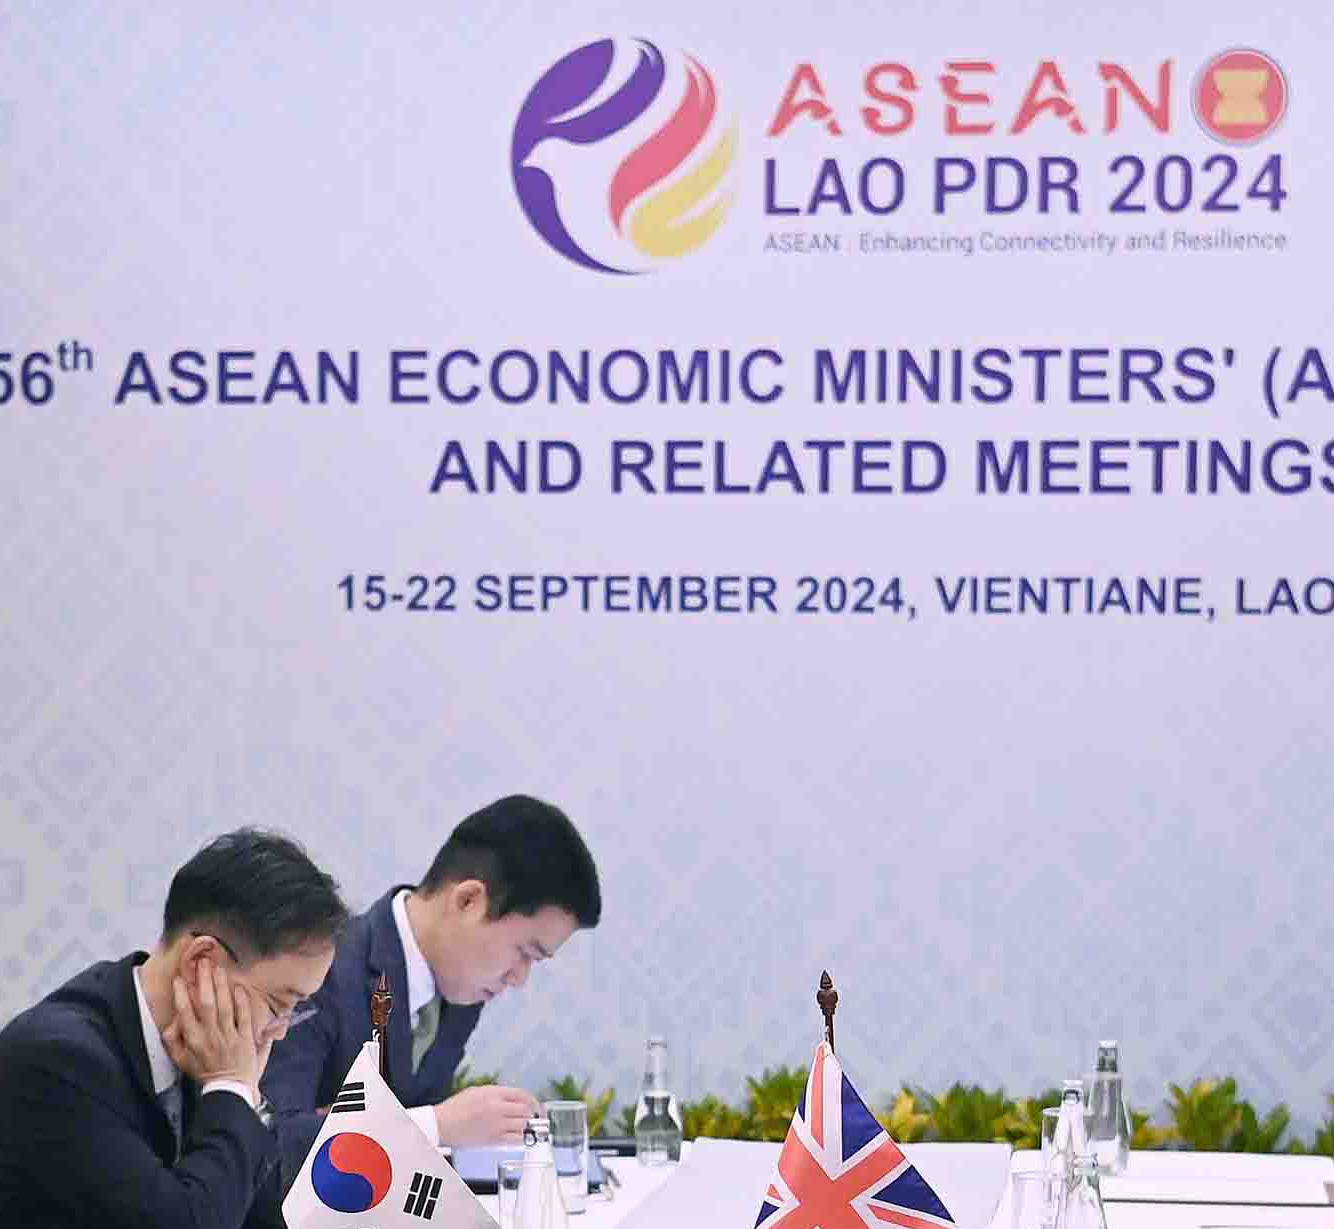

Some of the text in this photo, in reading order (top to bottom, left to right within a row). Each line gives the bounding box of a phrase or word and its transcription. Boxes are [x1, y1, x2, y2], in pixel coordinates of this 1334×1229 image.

[766, 59, 1173, 137] ASEAN
[764, 153, 1288, 216] LAO PDR 2024
[764, 228, 1288, 257] ASEAN Enhancing Connectivity and Resilience
[113, 349, 360, 405] ASEAN
[389, 348, 784, 404] ECONOMIC
[814, 346, 1235, 404] MINISTERS'
[429, 439, 583, 495] AND
[610, 439, 948, 495] RELATED
[337, 574, 457, 612] 15-22
[474, 574, 778, 613] SEPTEMBER
[794, 575, 916, 620] 2024,
[934, 575, 1215, 621] VIENTIANE,
